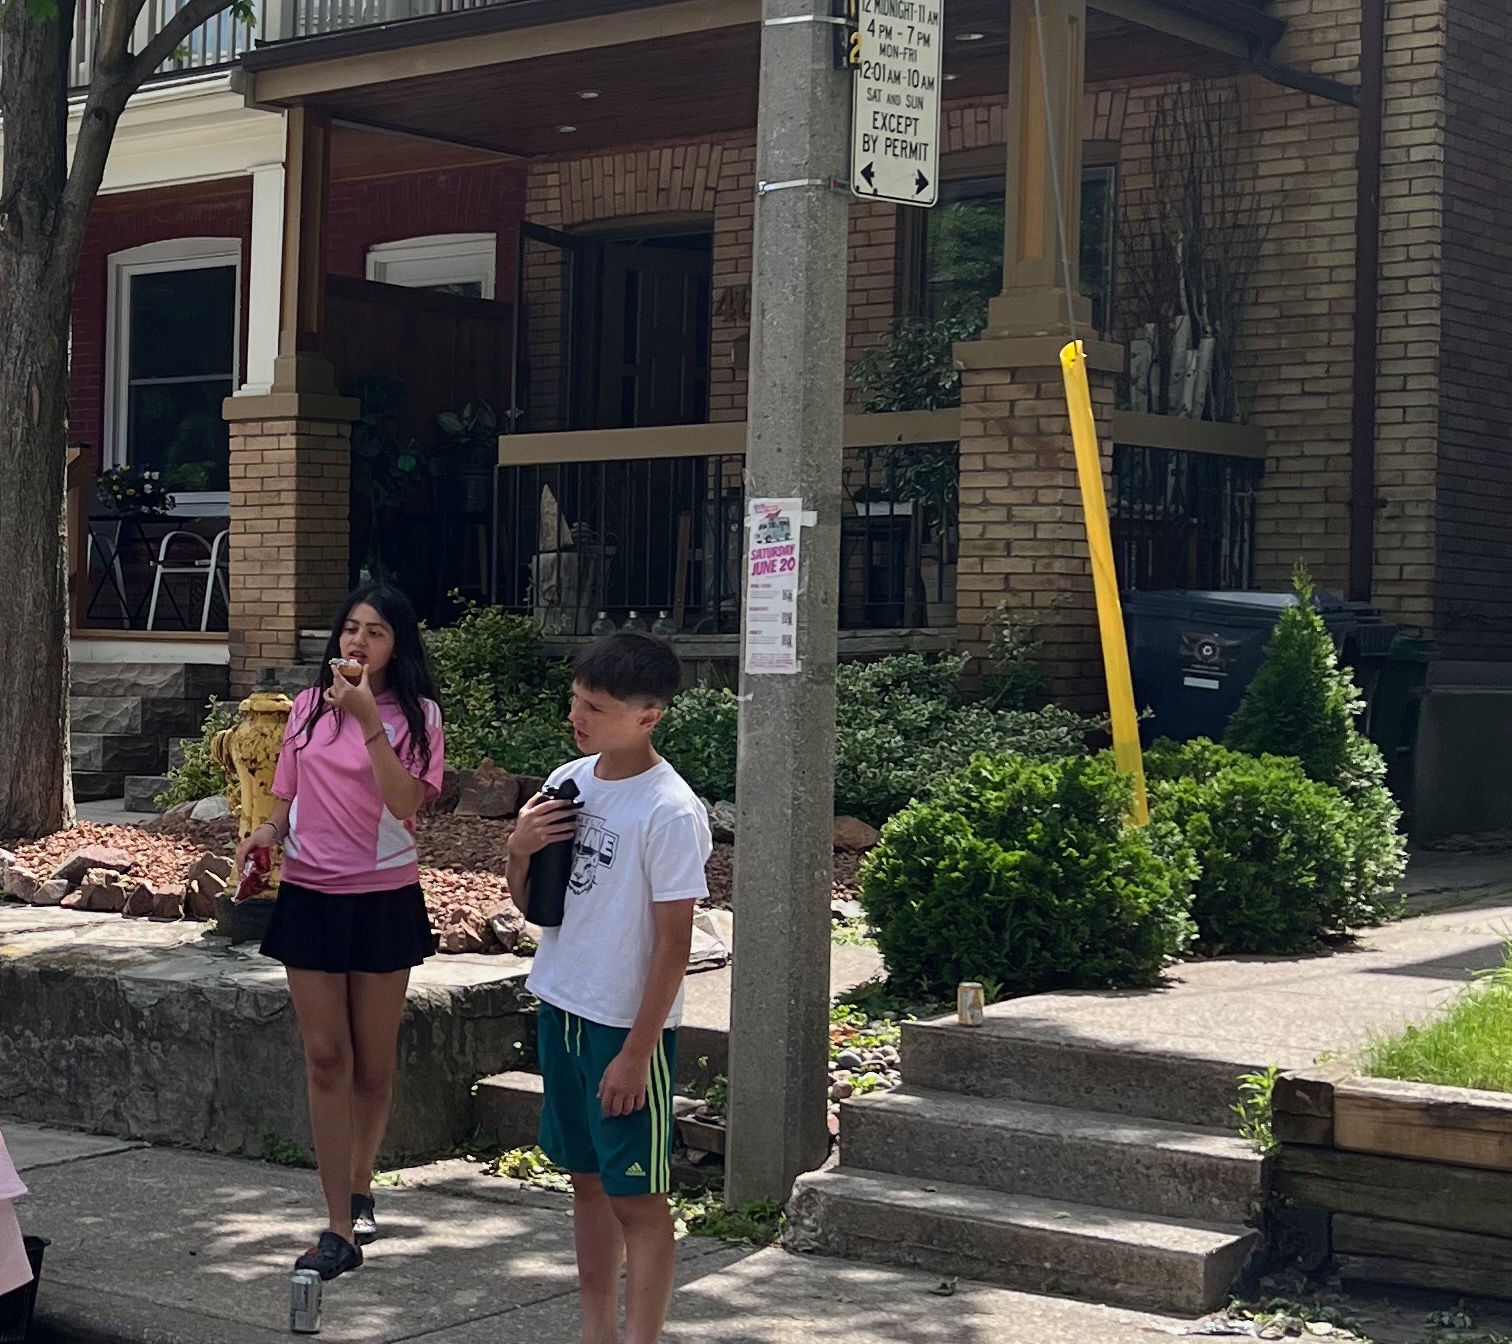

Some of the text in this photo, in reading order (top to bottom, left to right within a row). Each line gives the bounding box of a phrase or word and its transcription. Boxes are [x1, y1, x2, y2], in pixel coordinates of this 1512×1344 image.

[927, 11, 938, 26] AM
[867, 18, 875, 37] 4
[879, 24, 892, 41] PM
[907, 25, 915, 44] 7
[917, 31, 930, 48] PM
[879, 42, 917, 62] MON-FRI
[920, 75, 934, 91] AM
[866, 87, 924, 111] SAT AND SUN
[872, 110, 919, 136] EXCEPT
[862, 133, 929, 161] BY PERMIT
[751, 544, 796, 561] SATURDAY
[752, 556, 796, 576] JUNE 20
